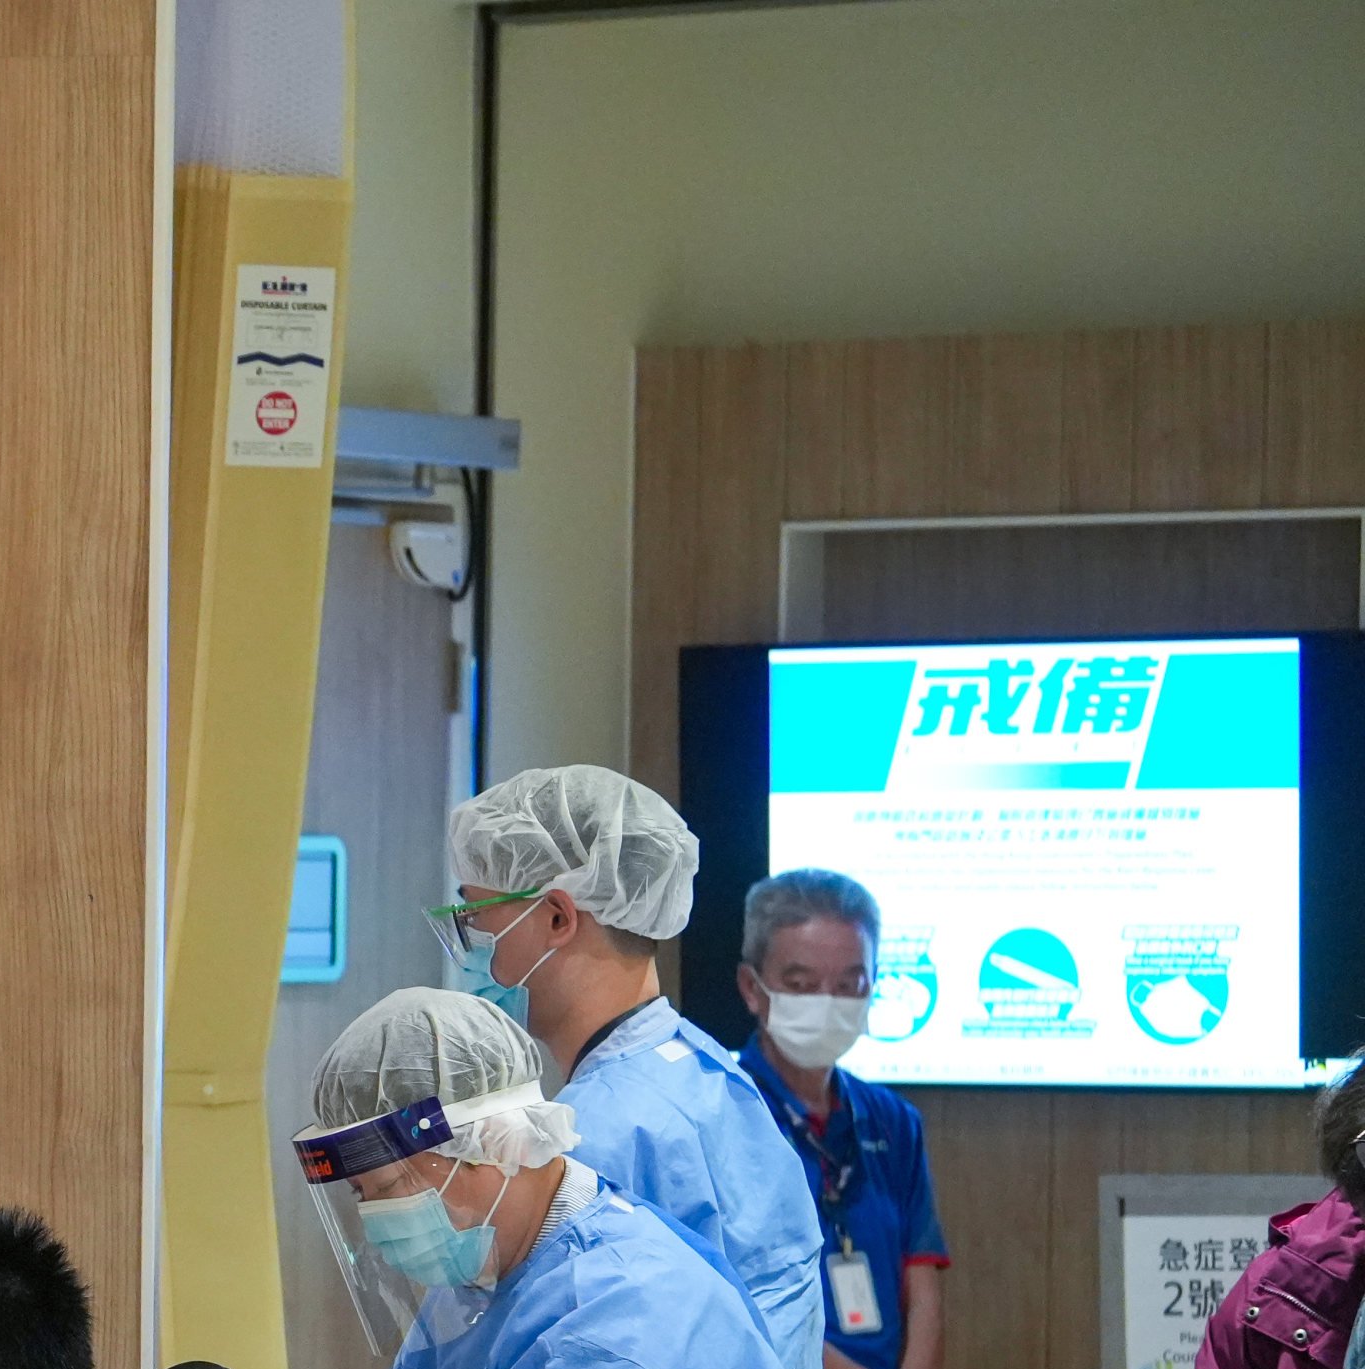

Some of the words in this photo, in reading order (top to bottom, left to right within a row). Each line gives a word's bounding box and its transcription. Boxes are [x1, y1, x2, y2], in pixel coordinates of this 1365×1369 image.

[911, 656, 1160, 736] 戒備
[1159, 1238, 1270, 1271] 急症登
